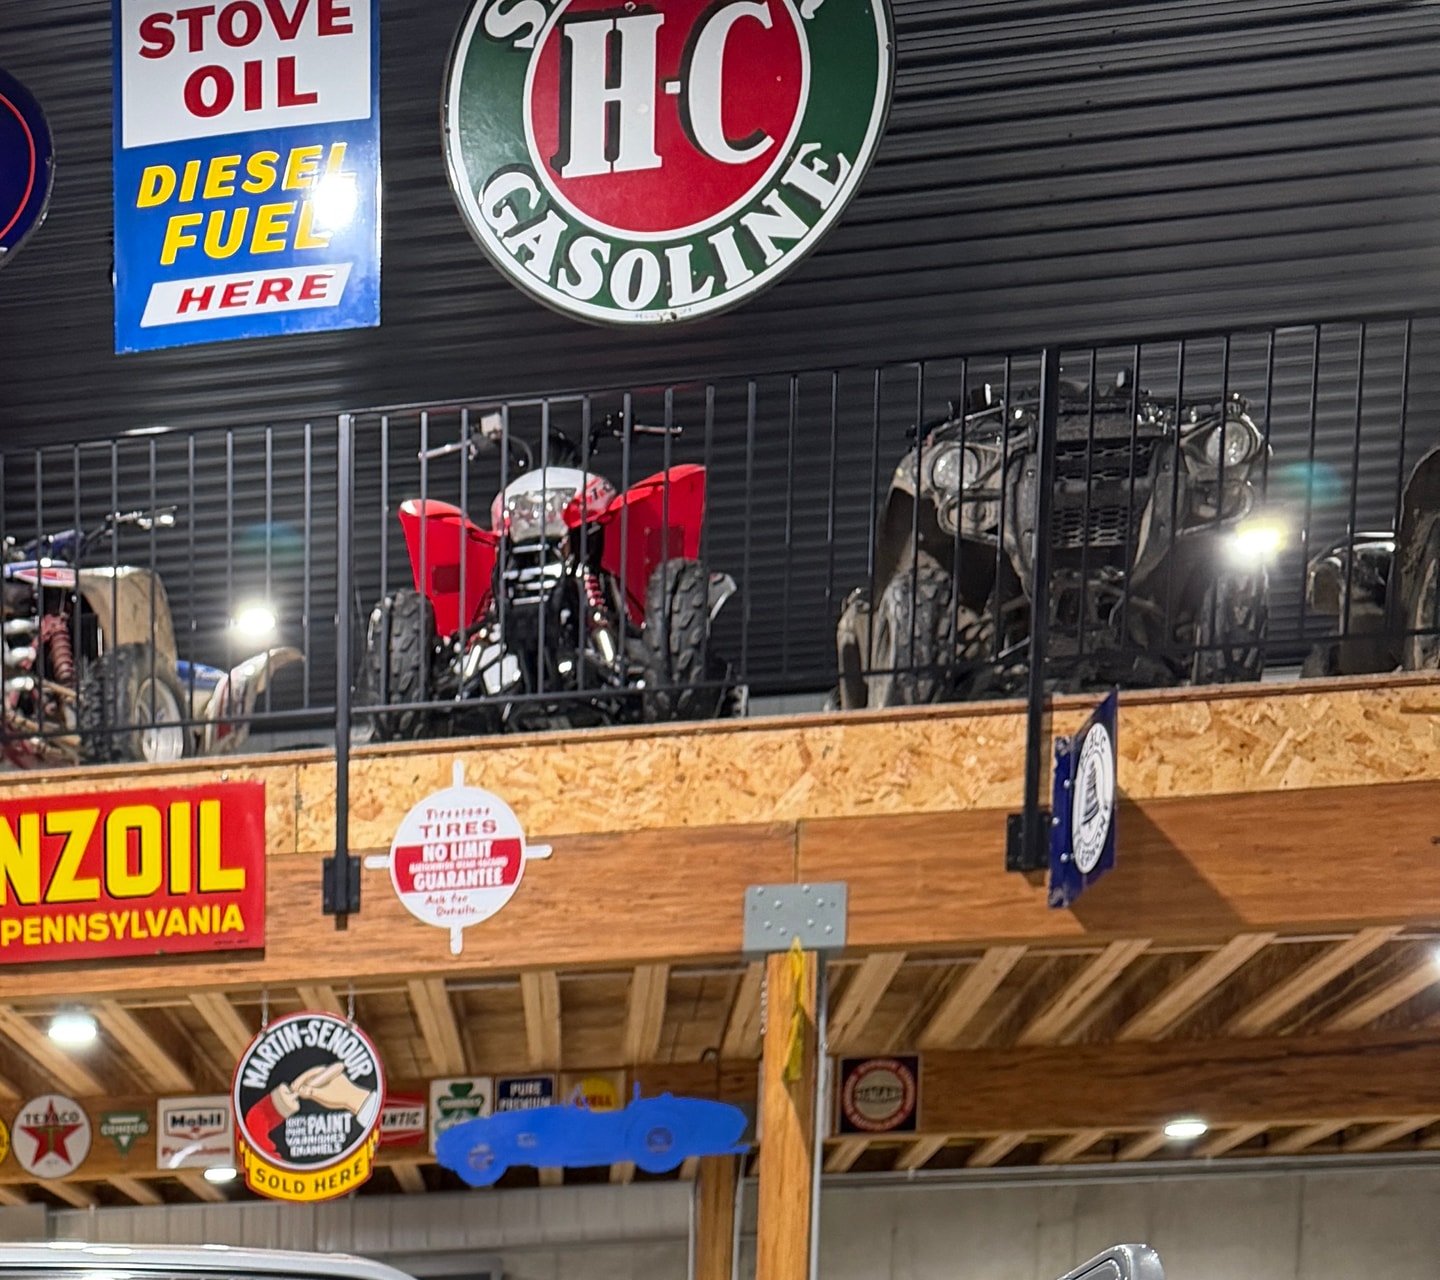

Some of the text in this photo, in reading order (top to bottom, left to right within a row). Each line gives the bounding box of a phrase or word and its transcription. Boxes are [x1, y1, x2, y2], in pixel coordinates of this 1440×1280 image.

[137, 0, 354, 60] STOVE
[183, 56, 318, 118] OIL
[135, 143, 356, 209] DIESEL
[160, 201, 334, 265] FUEL
[478, 142, 851, 310] GASOLINE
[176, 274, 336, 314] HERE
[419, 819, 497, 838] TIRES
[423, 840, 493, 862] NO LIMIT
[413, 868, 503, 891] GUARANTEE
[0, 904, 245, 948] PENNSYLVANIA
[243, 1020, 373, 1088] MARTIN-SENOUR
[510, 1081, 542, 1095] PURE
[24, 1112, 79, 1124] TEXACO
[170, 1114, 221, 1127] Mobil
[307, 1112, 352, 1135] PAINT
[255, 1159, 363, 1194] SOLD HERE
